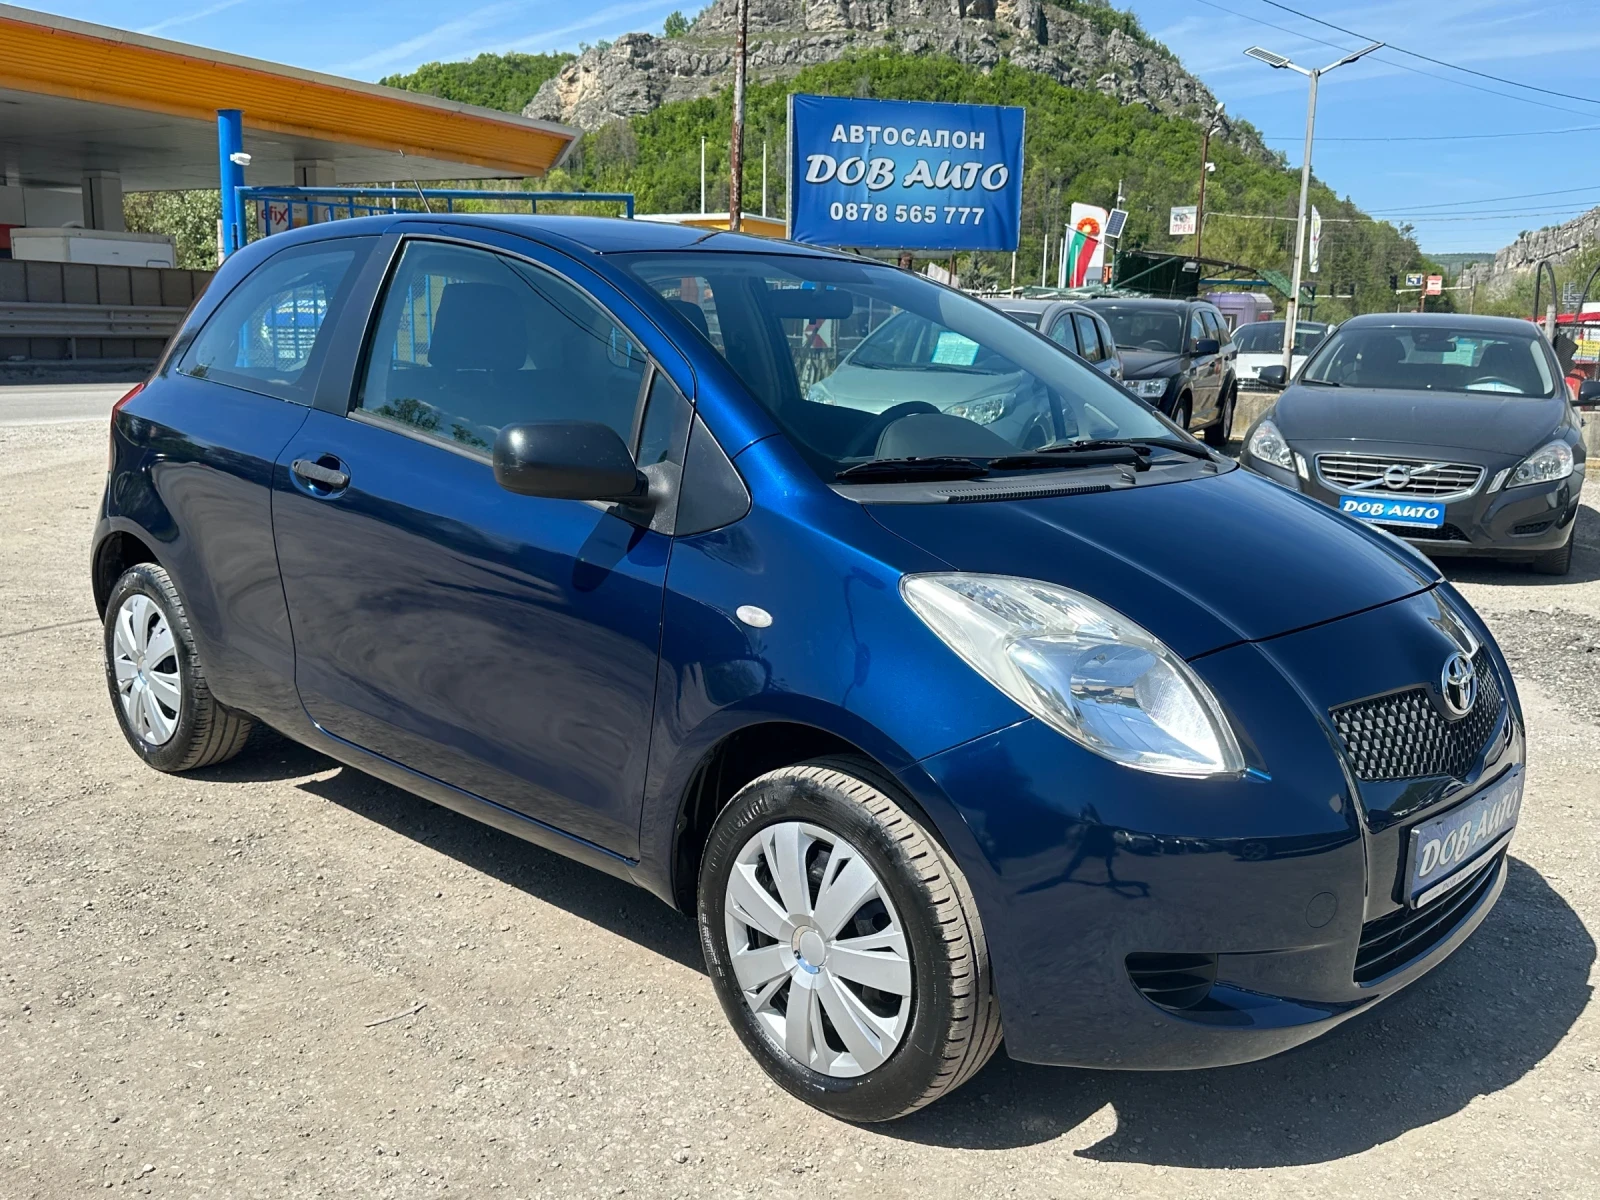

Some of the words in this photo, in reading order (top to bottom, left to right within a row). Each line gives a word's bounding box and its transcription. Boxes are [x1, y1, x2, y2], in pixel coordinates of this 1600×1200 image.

[831, 124, 985, 149] АВТОСАЛОН
[805, 154, 895, 191] DOB
[902, 159, 1009, 192] AUTO
[829, 201, 888, 222] 0878
[895, 205, 937, 225] 565
[944, 206, 985, 226] 777
[1343, 500, 1384, 516] DOB
[1387, 505, 1440, 519] AUTO
[1419, 820, 1472, 877] DOB
[1471, 786, 1519, 845] AUTO
